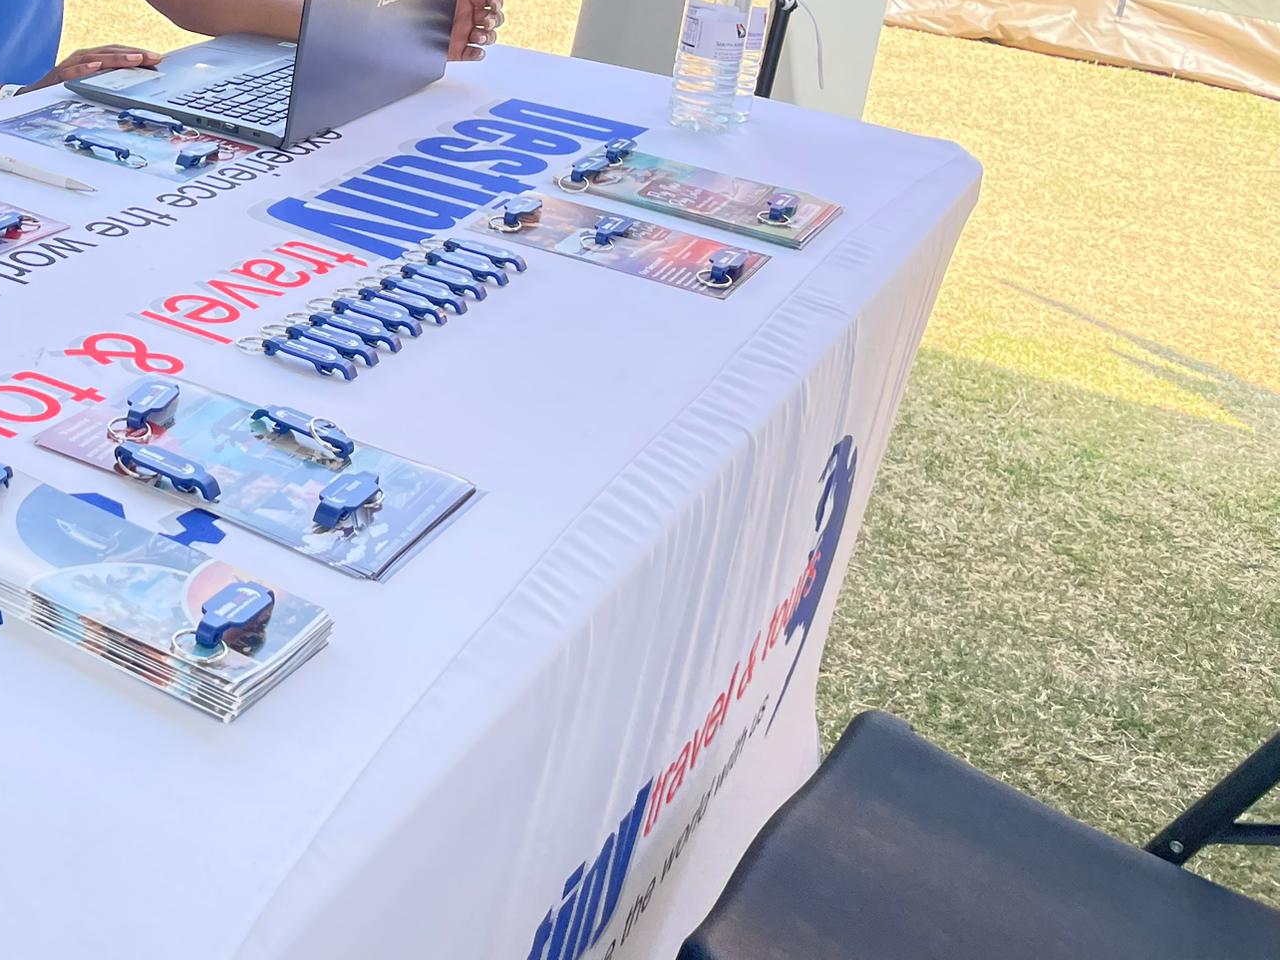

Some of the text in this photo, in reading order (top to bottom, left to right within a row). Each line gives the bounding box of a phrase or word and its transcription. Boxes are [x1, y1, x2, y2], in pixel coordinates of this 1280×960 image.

[86, 205, 178, 239] the
[141, 240, 368, 344] travel
[64, 332, 185, 375] &
[643, 662, 740, 837] travel
[621, 876, 657, 946] the
[661, 788, 713, 884] world
